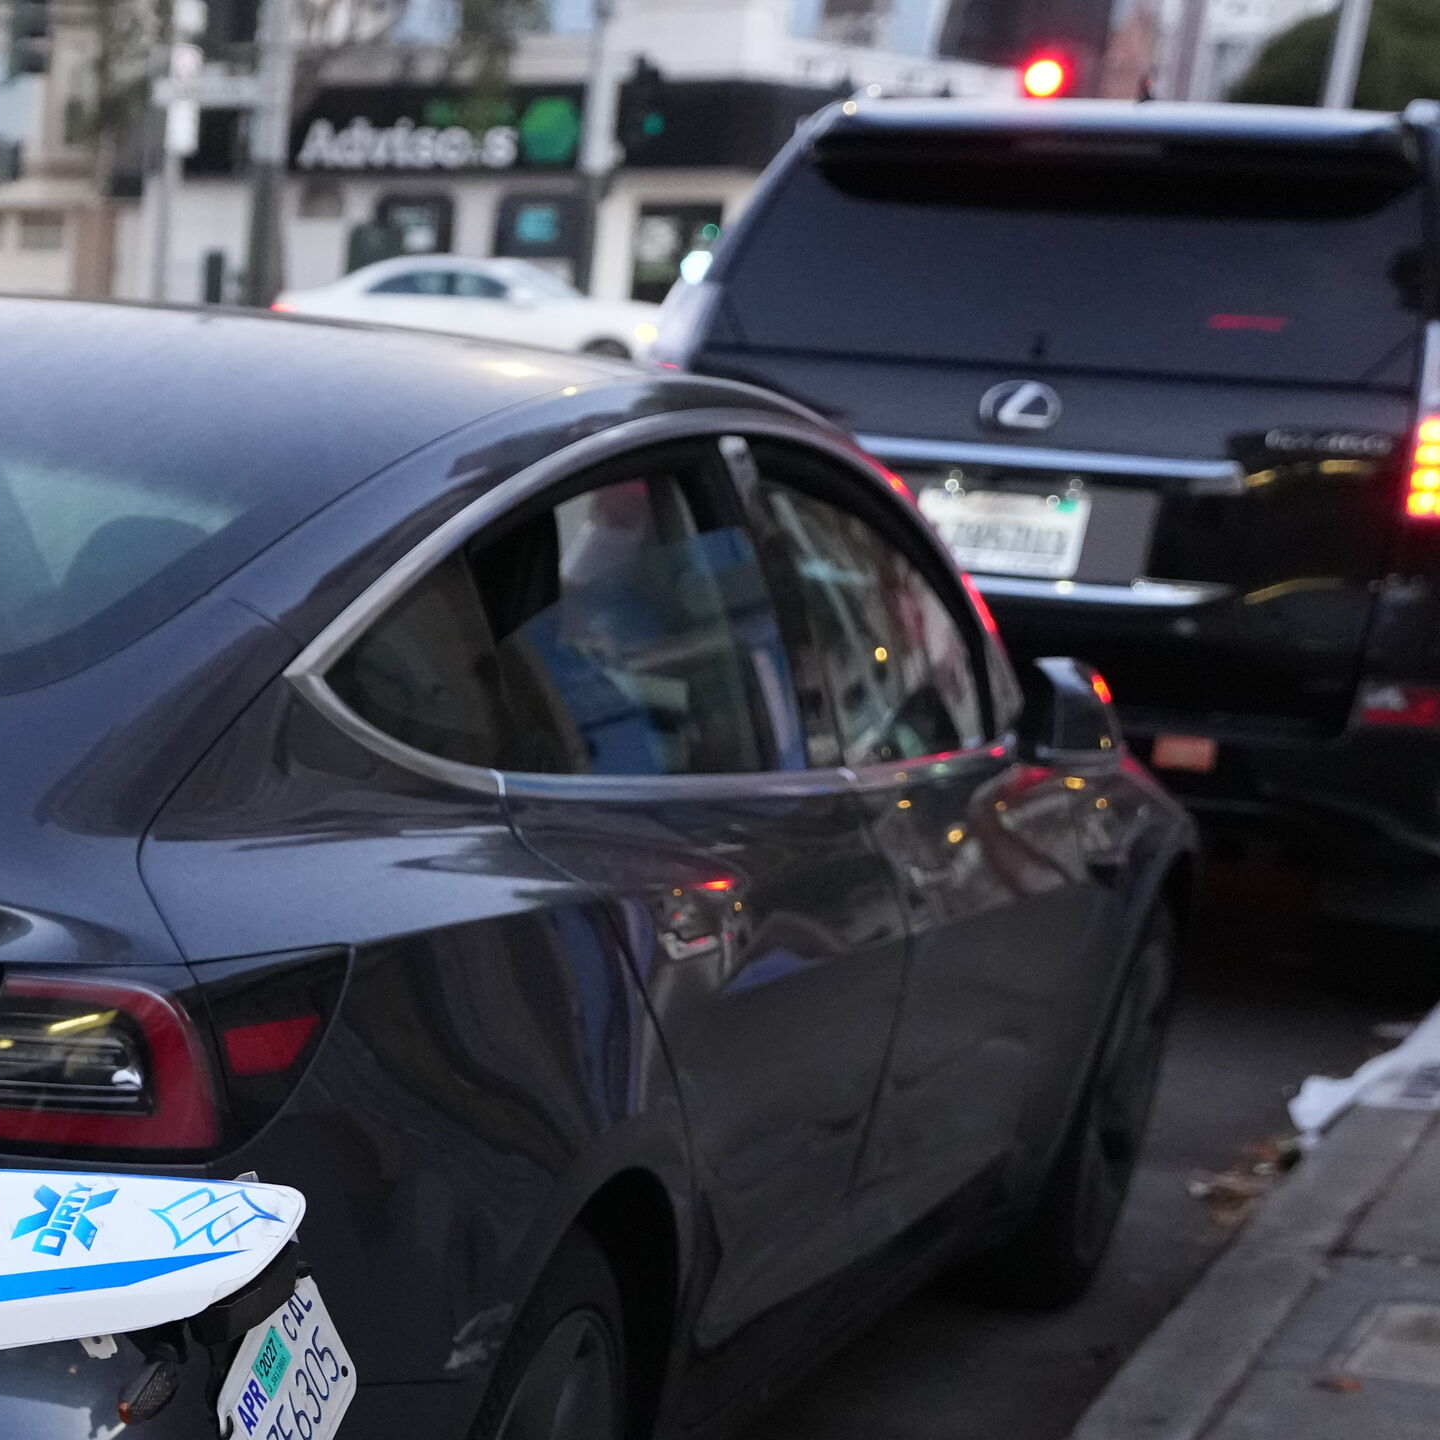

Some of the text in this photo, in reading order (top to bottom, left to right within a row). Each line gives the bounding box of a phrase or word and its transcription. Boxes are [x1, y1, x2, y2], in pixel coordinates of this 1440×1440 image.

[295, 115, 520, 169] Advisos
[32, 1182, 93, 1256] DIRTY
[282, 1293, 313, 1341] CAL
[259, 1337, 278, 1378] 2027
[237, 1378, 268, 1436] APR
